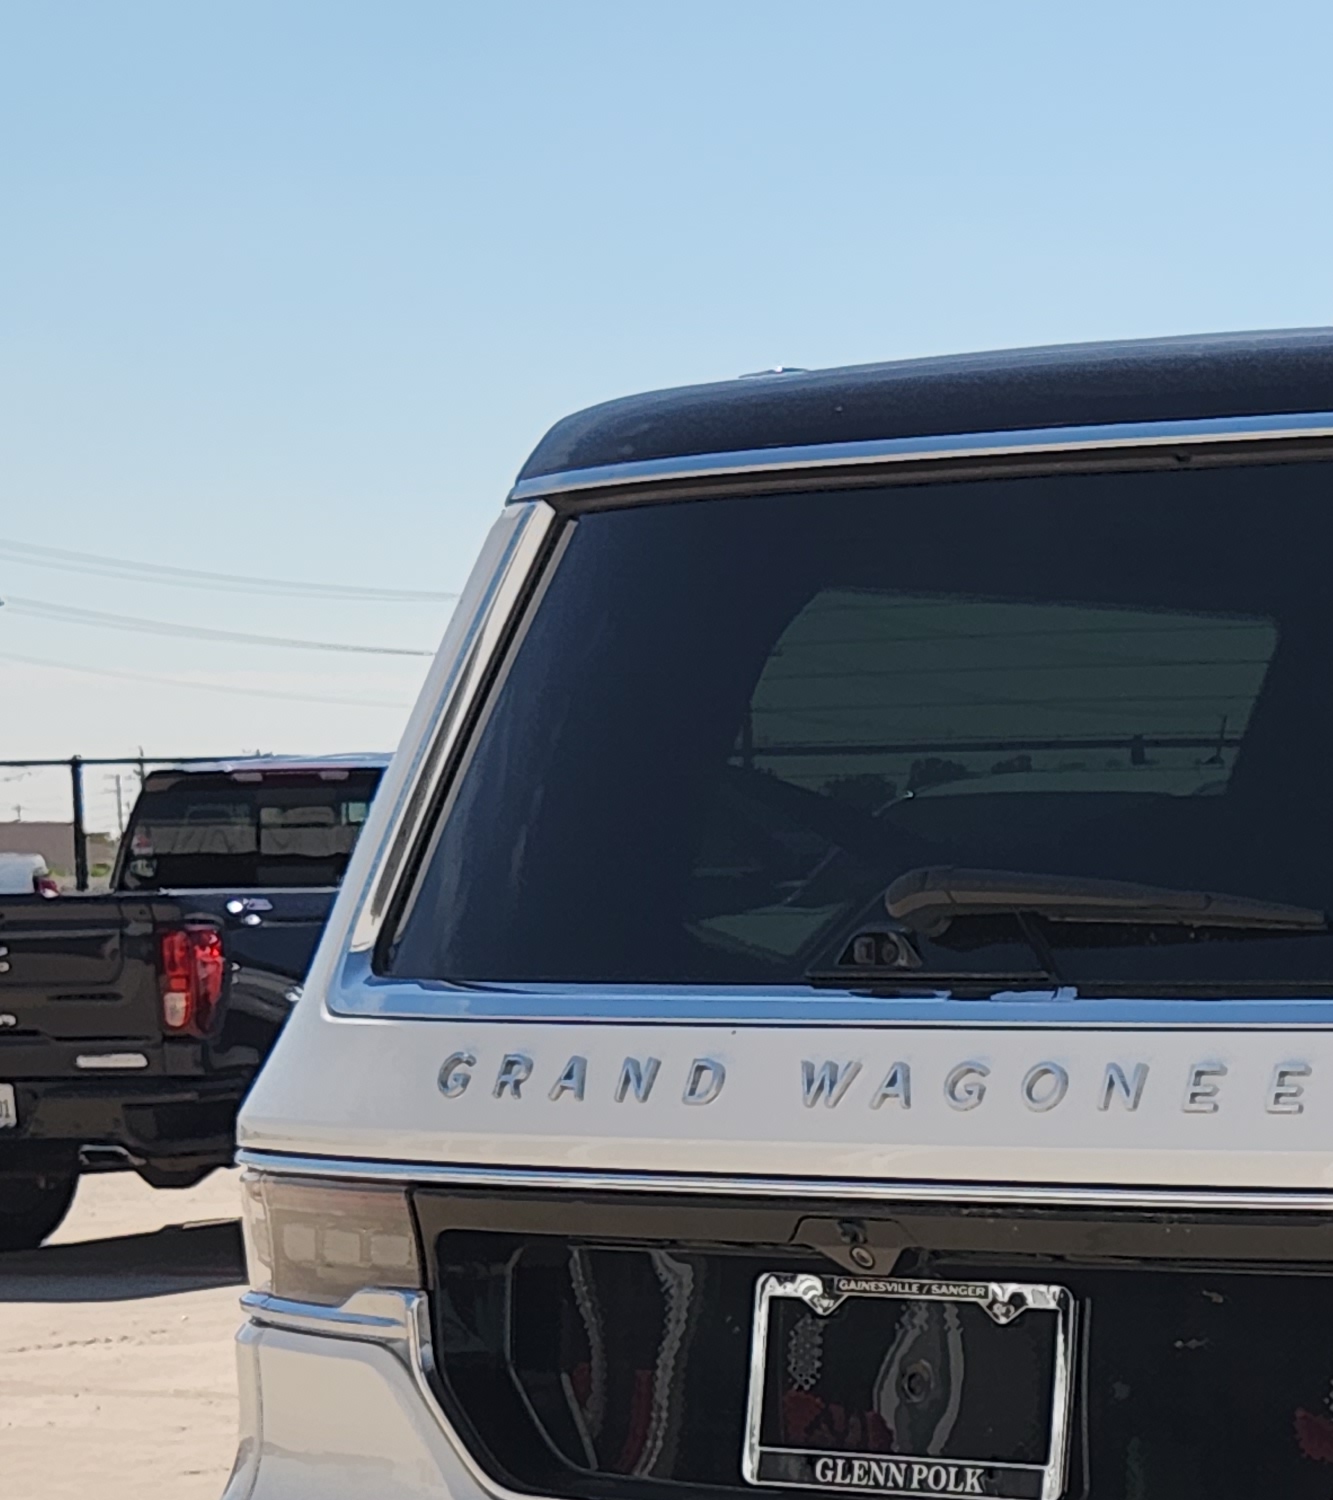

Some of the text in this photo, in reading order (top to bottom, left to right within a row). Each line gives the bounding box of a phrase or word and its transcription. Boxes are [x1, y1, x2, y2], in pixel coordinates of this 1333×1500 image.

[437, 1051, 726, 1106] GRAND
[838, 1279, 920, 1295] GAINESVILLE
[931, 1284, 986, 1297] SANGER
[815, 1457, 985, 1494] GLENN POLK
